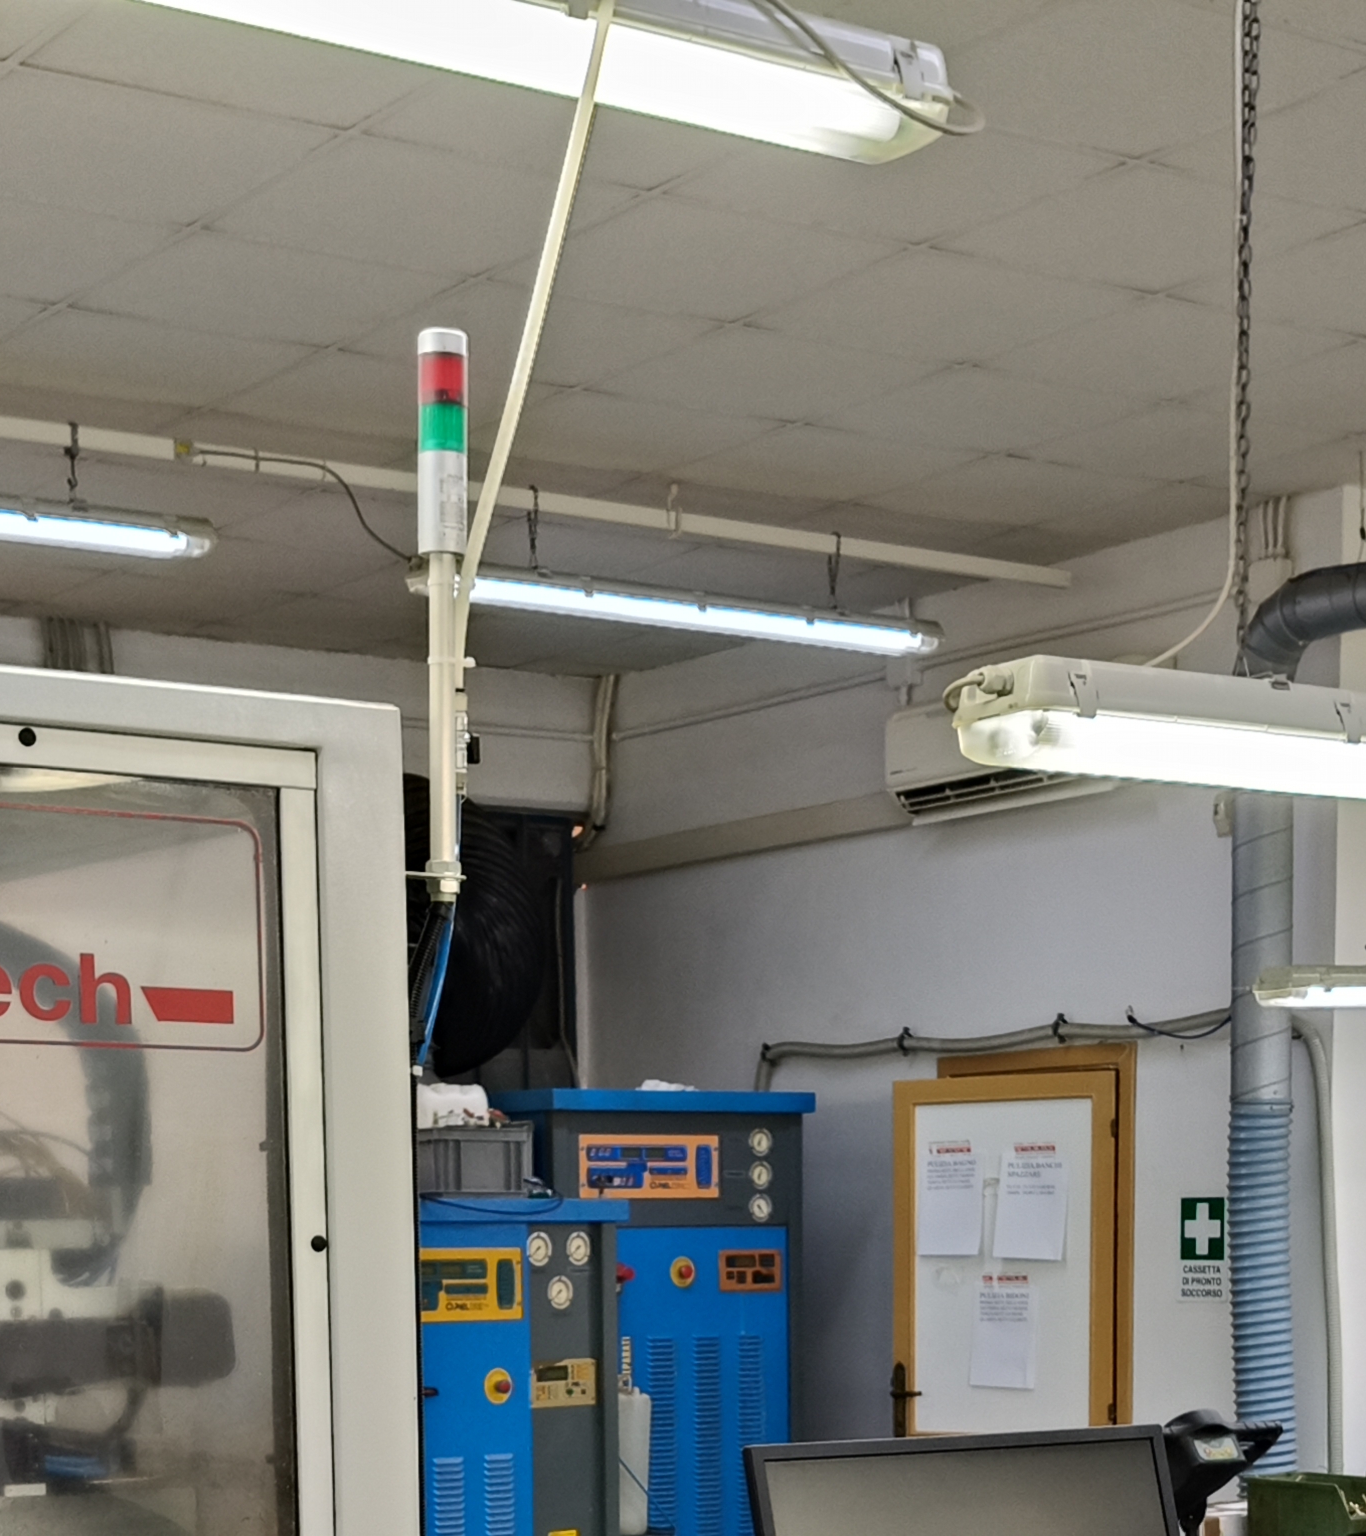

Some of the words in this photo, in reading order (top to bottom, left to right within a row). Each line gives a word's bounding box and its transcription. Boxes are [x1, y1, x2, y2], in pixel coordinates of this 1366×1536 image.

[1182, 1264, 1221, 1274] CASSETTA
[1182, 1276, 1190, 1286] DI
[1191, 1276, 1222, 1286] PRONTO
[1181, 1288, 1223, 1298] SOCCORSO
